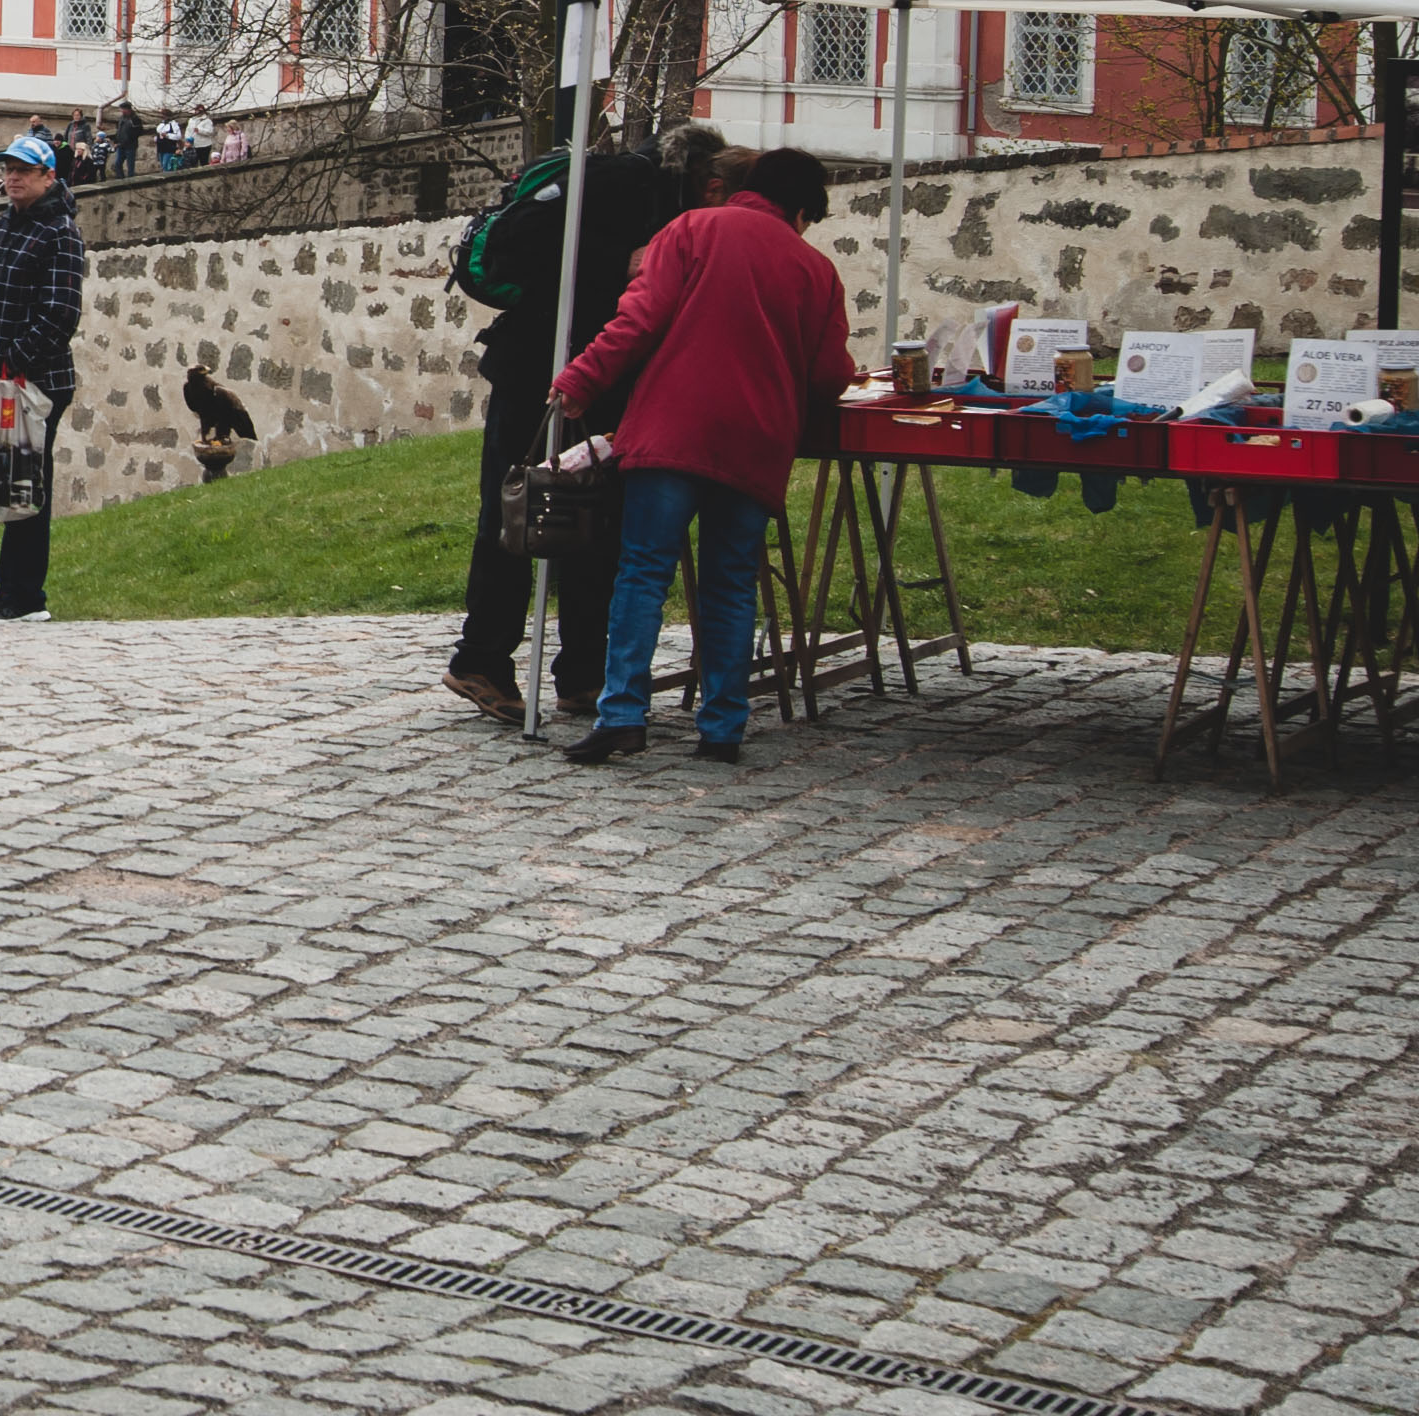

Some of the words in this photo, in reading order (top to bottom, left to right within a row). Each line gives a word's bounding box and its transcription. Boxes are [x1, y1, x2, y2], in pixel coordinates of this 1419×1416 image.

[1128, 342, 1171, 352] JAHODY
[1301, 350, 1331, 360] ALOE
[1334, 352, 1363, 362] VERA
[1023, 380, 1054, 392] 32,50
[1306, 400, 1342, 413] 27,50
